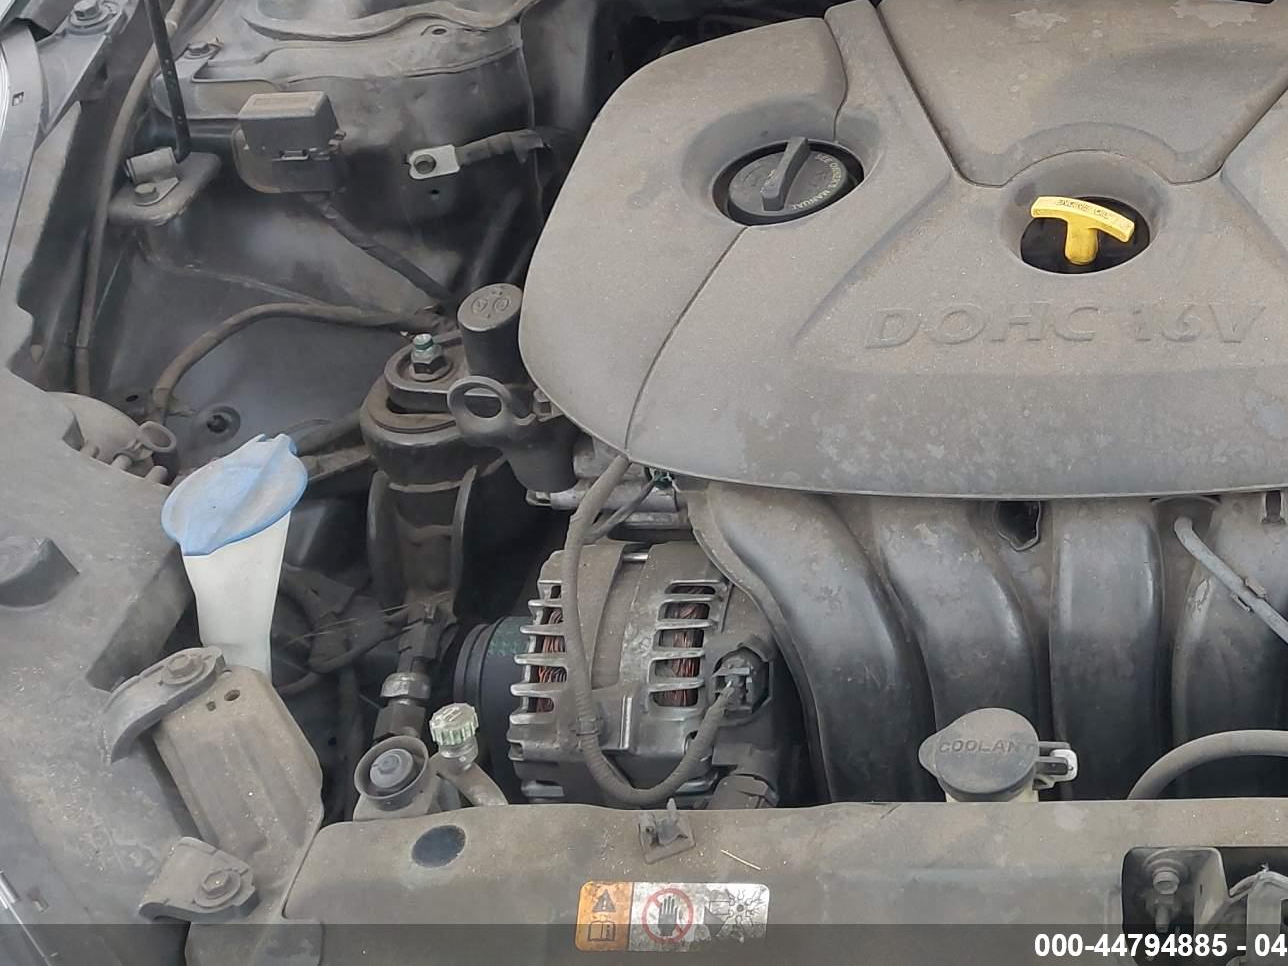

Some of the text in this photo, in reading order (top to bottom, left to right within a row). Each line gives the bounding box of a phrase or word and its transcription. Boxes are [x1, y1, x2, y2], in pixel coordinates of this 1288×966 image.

[791, 189, 831, 211] MANUAL
[865, 301, 1267, 349] DOHC 16V
[938, 737, 1035, 755] COOLANT
